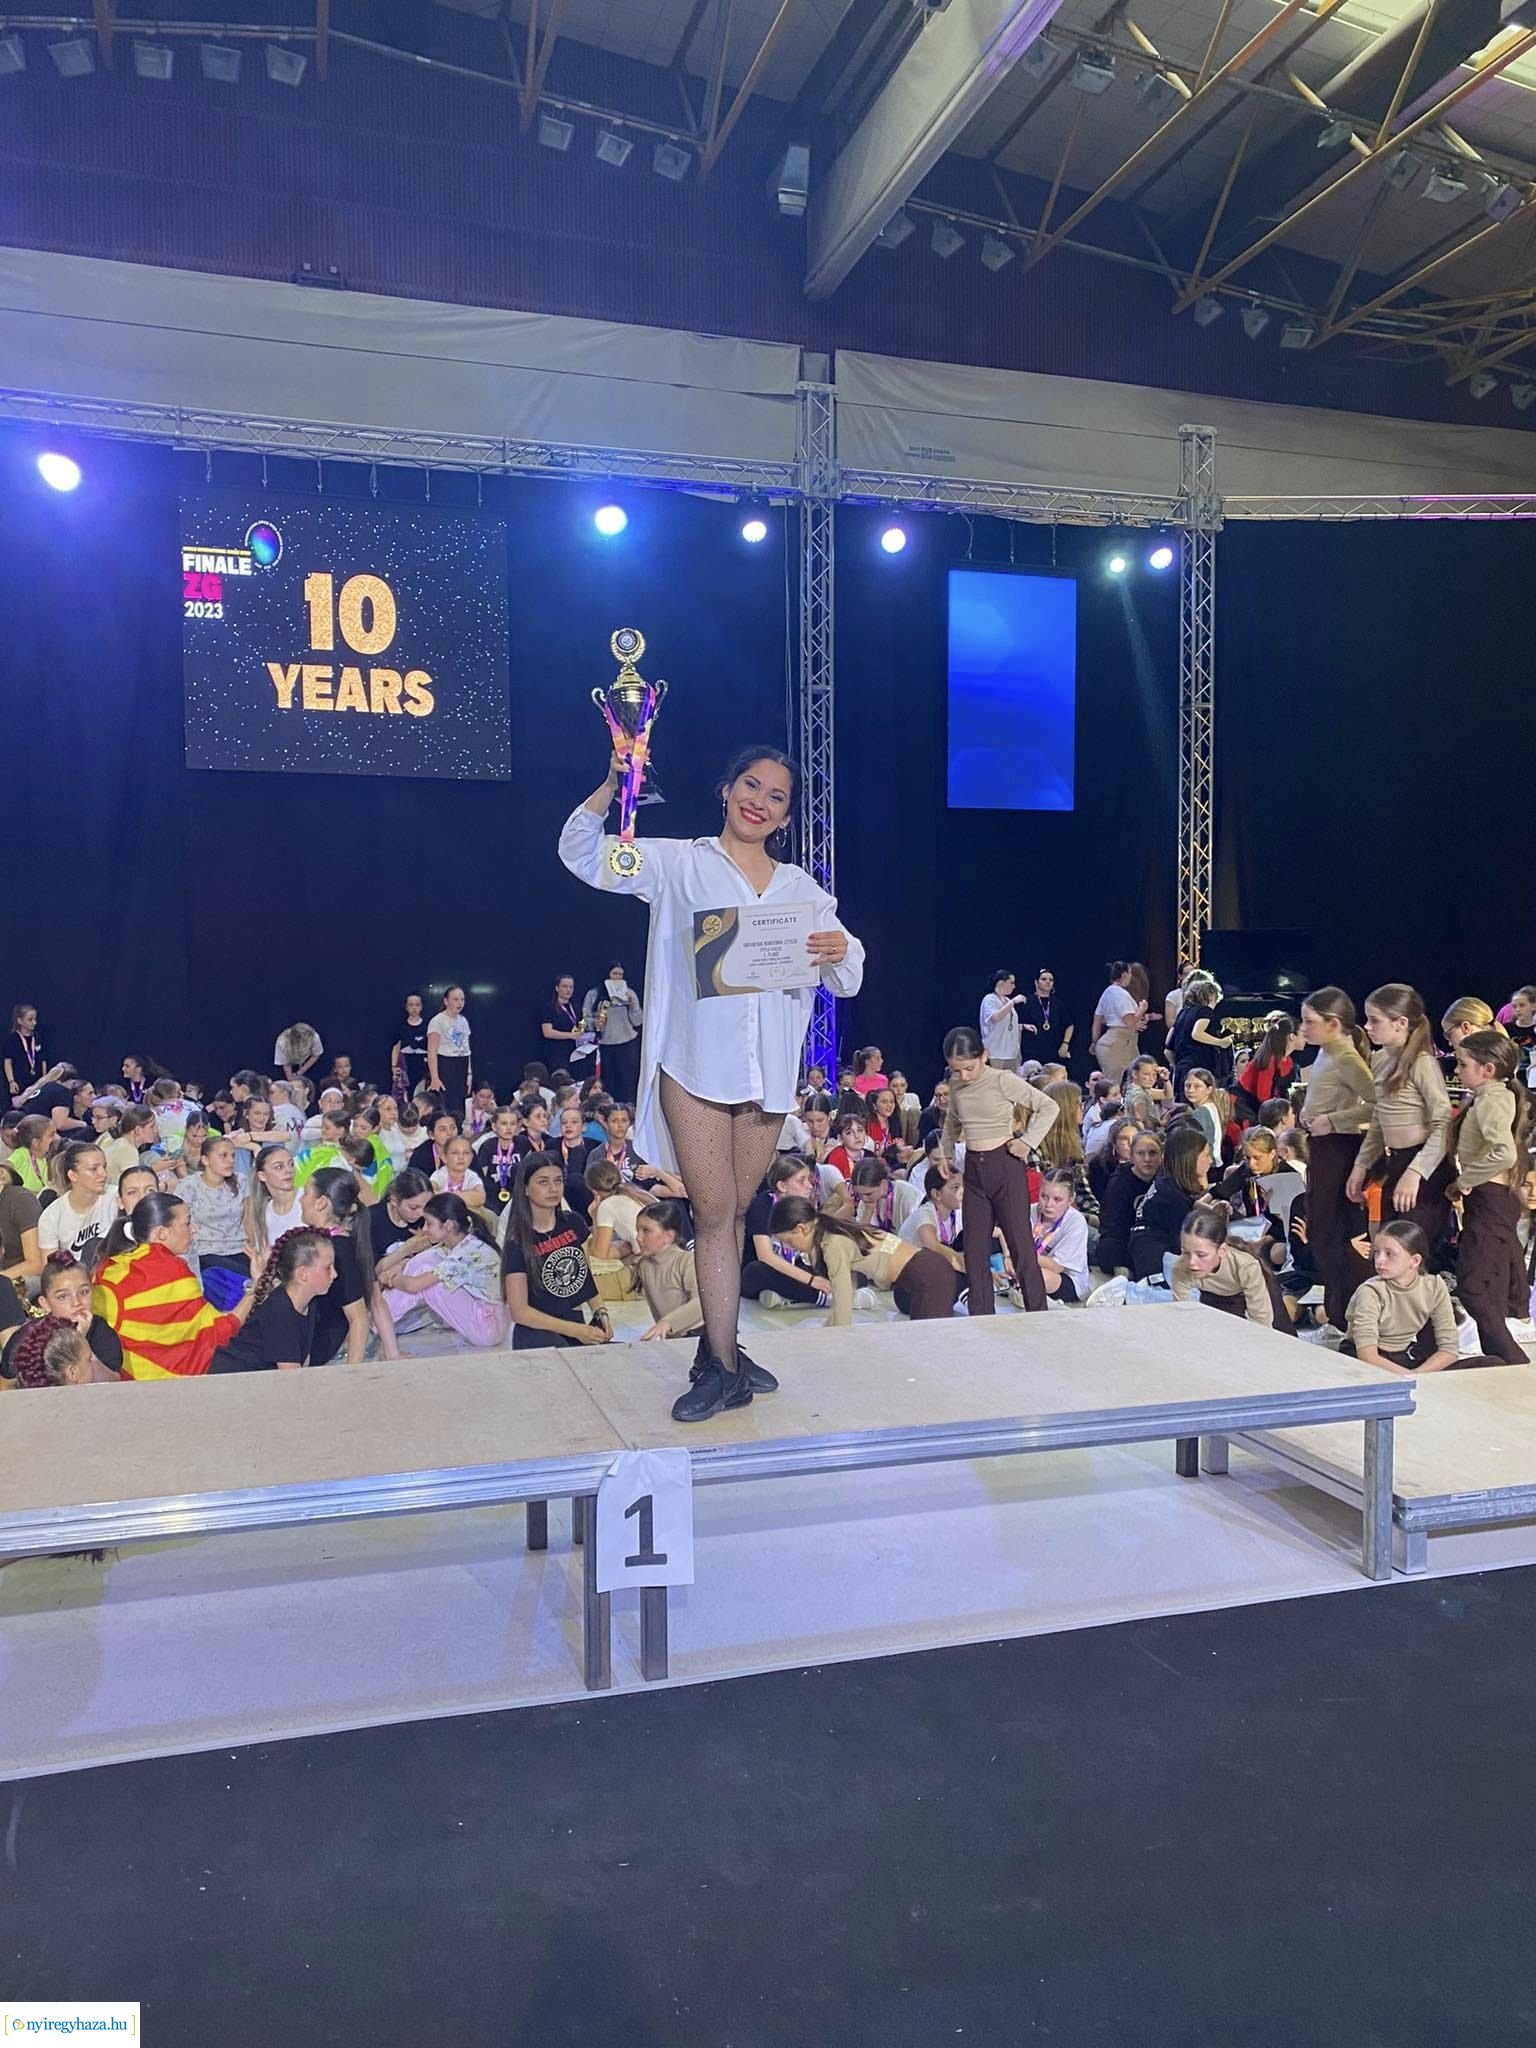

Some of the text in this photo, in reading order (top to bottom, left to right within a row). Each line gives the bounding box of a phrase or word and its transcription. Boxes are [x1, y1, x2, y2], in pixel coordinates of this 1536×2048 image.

[183, 554, 252, 576] FINALE
[183, 573, 223, 600] ZG
[184, 601, 223, 619] 2023
[303, 572, 397, 655] 10
[266, 662, 436, 717] YEARS
[752, 916, 797, 926] CERTIFICATE
[76, 1222, 100, 1243] NIKE
[624, 1494, 668, 1568] 1
